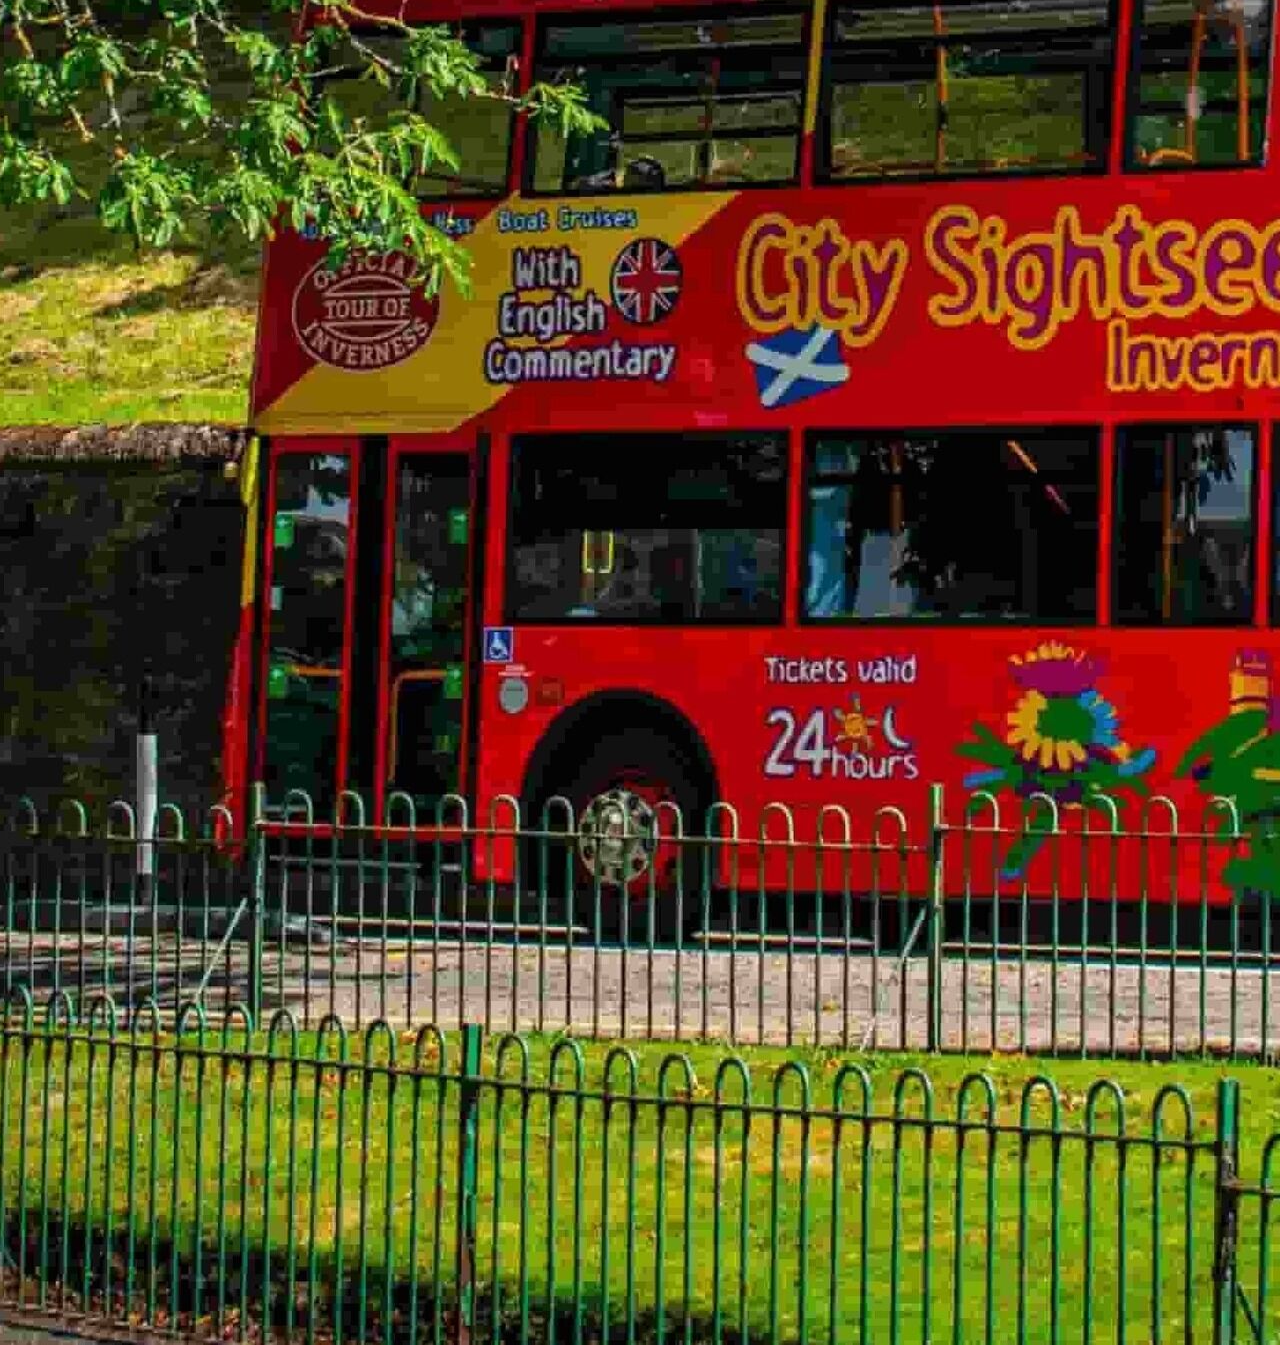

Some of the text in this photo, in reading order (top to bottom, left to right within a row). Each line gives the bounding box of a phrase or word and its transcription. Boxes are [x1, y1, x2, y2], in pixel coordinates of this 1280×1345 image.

[498, 209, 549, 233] Boat
[558, 206, 638, 231] Cruises
[513, 247, 580, 290] With
[736, 212, 907, 347] City
[324, 297, 411, 319] TOUR OF
[499, 289, 607, 339] English
[301, 317, 430, 367] INVERNESS
[484, 340, 676, 383] Commentary
[764, 654, 917, 684] Tickets valid
[764, 708, 831, 777] 24
